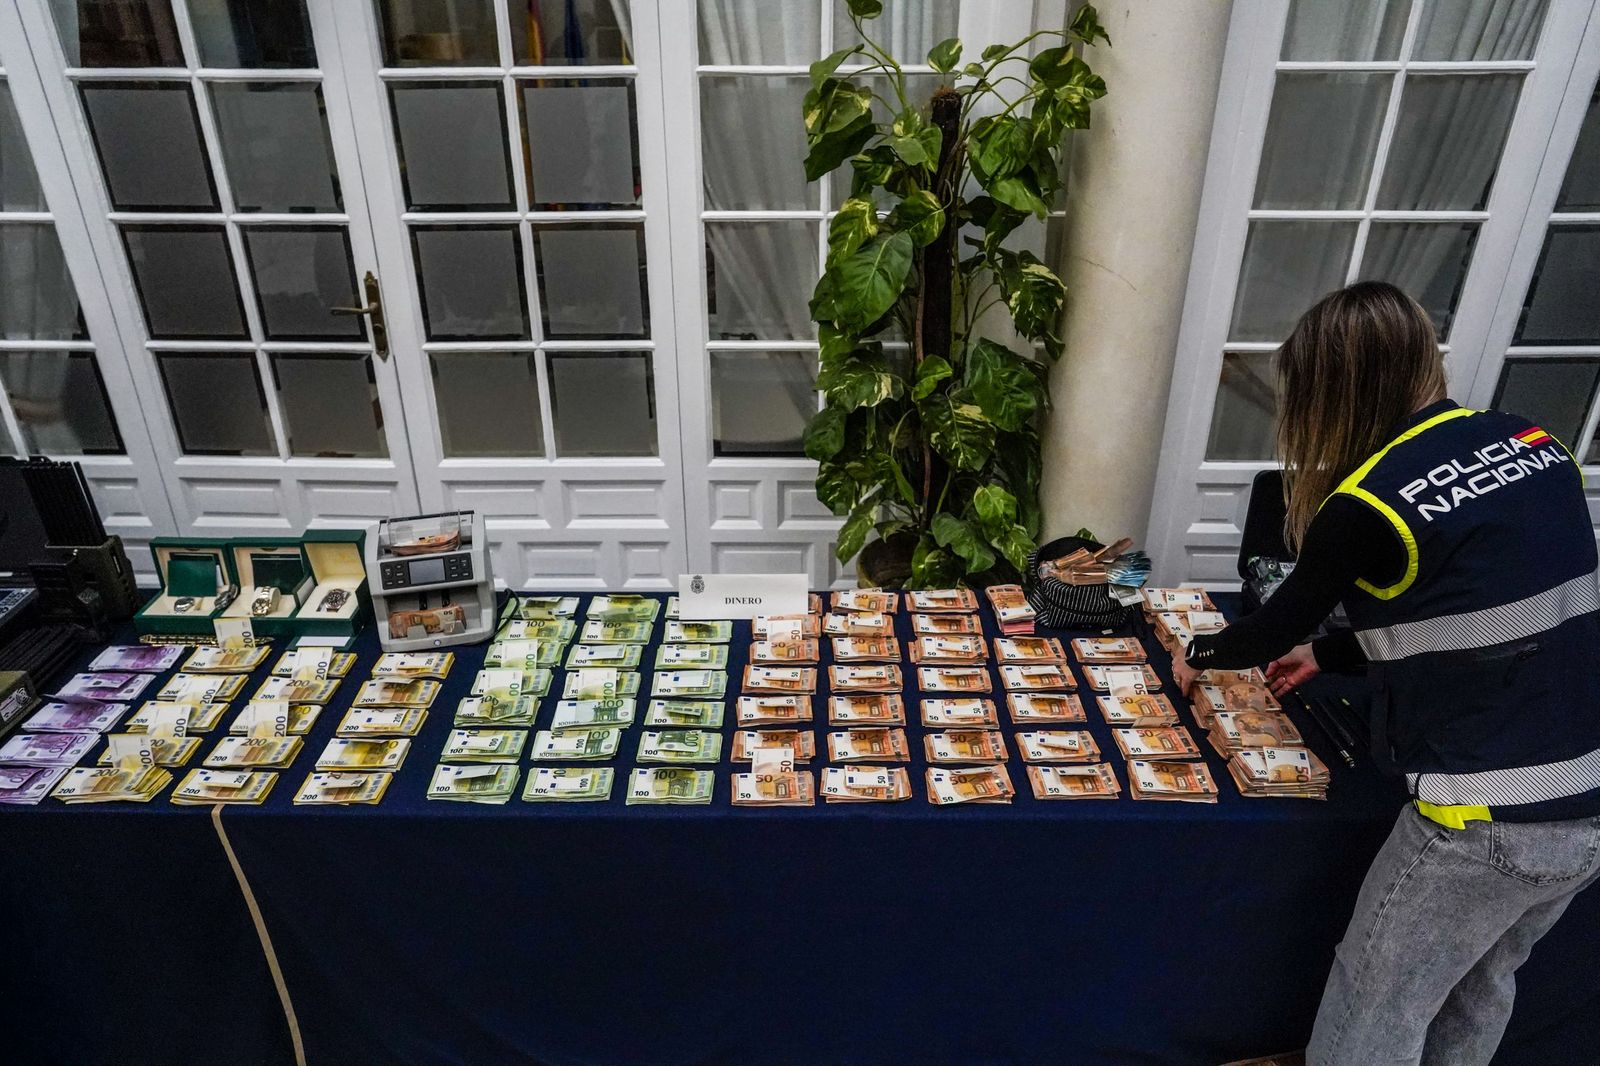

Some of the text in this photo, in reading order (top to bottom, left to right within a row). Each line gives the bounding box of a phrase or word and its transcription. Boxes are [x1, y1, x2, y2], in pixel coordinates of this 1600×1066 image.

[1398, 437, 1532, 504] POLICÍA
[1417, 445, 1570, 522] NACIONAL
[725, 597, 762, 605] DINERO
[525, 620, 545, 628] 100
[242, 631, 254, 648] 200
[791, 630, 801, 640] 50
[315, 661, 328, 680] 200
[603, 682, 614, 700] 100
[1134, 683, 1146, 695] 50
[200, 689, 215, 704] 200
[173, 718, 186, 737] 200
[275, 716, 286, 737] 200
[762, 734, 779, 742] 50
[850, 733, 867, 741] 50
[1136, 729, 1153, 737] 50
[241, 738, 267, 746] 200
[950, 734, 966, 743] 50
[1267, 750, 1276, 760] 50
[781, 760, 792, 772] 50
[1152, 764, 1169, 773] 50
[91, 769, 120, 777] 200
[653, 770, 677, 780] 100
[1295, 766, 1309, 782] 50
[579, 778, 589, 788] 100
[756, 774, 773, 783] 50
[877, 775, 885, 784] 50
[950, 776, 967, 785] 50
